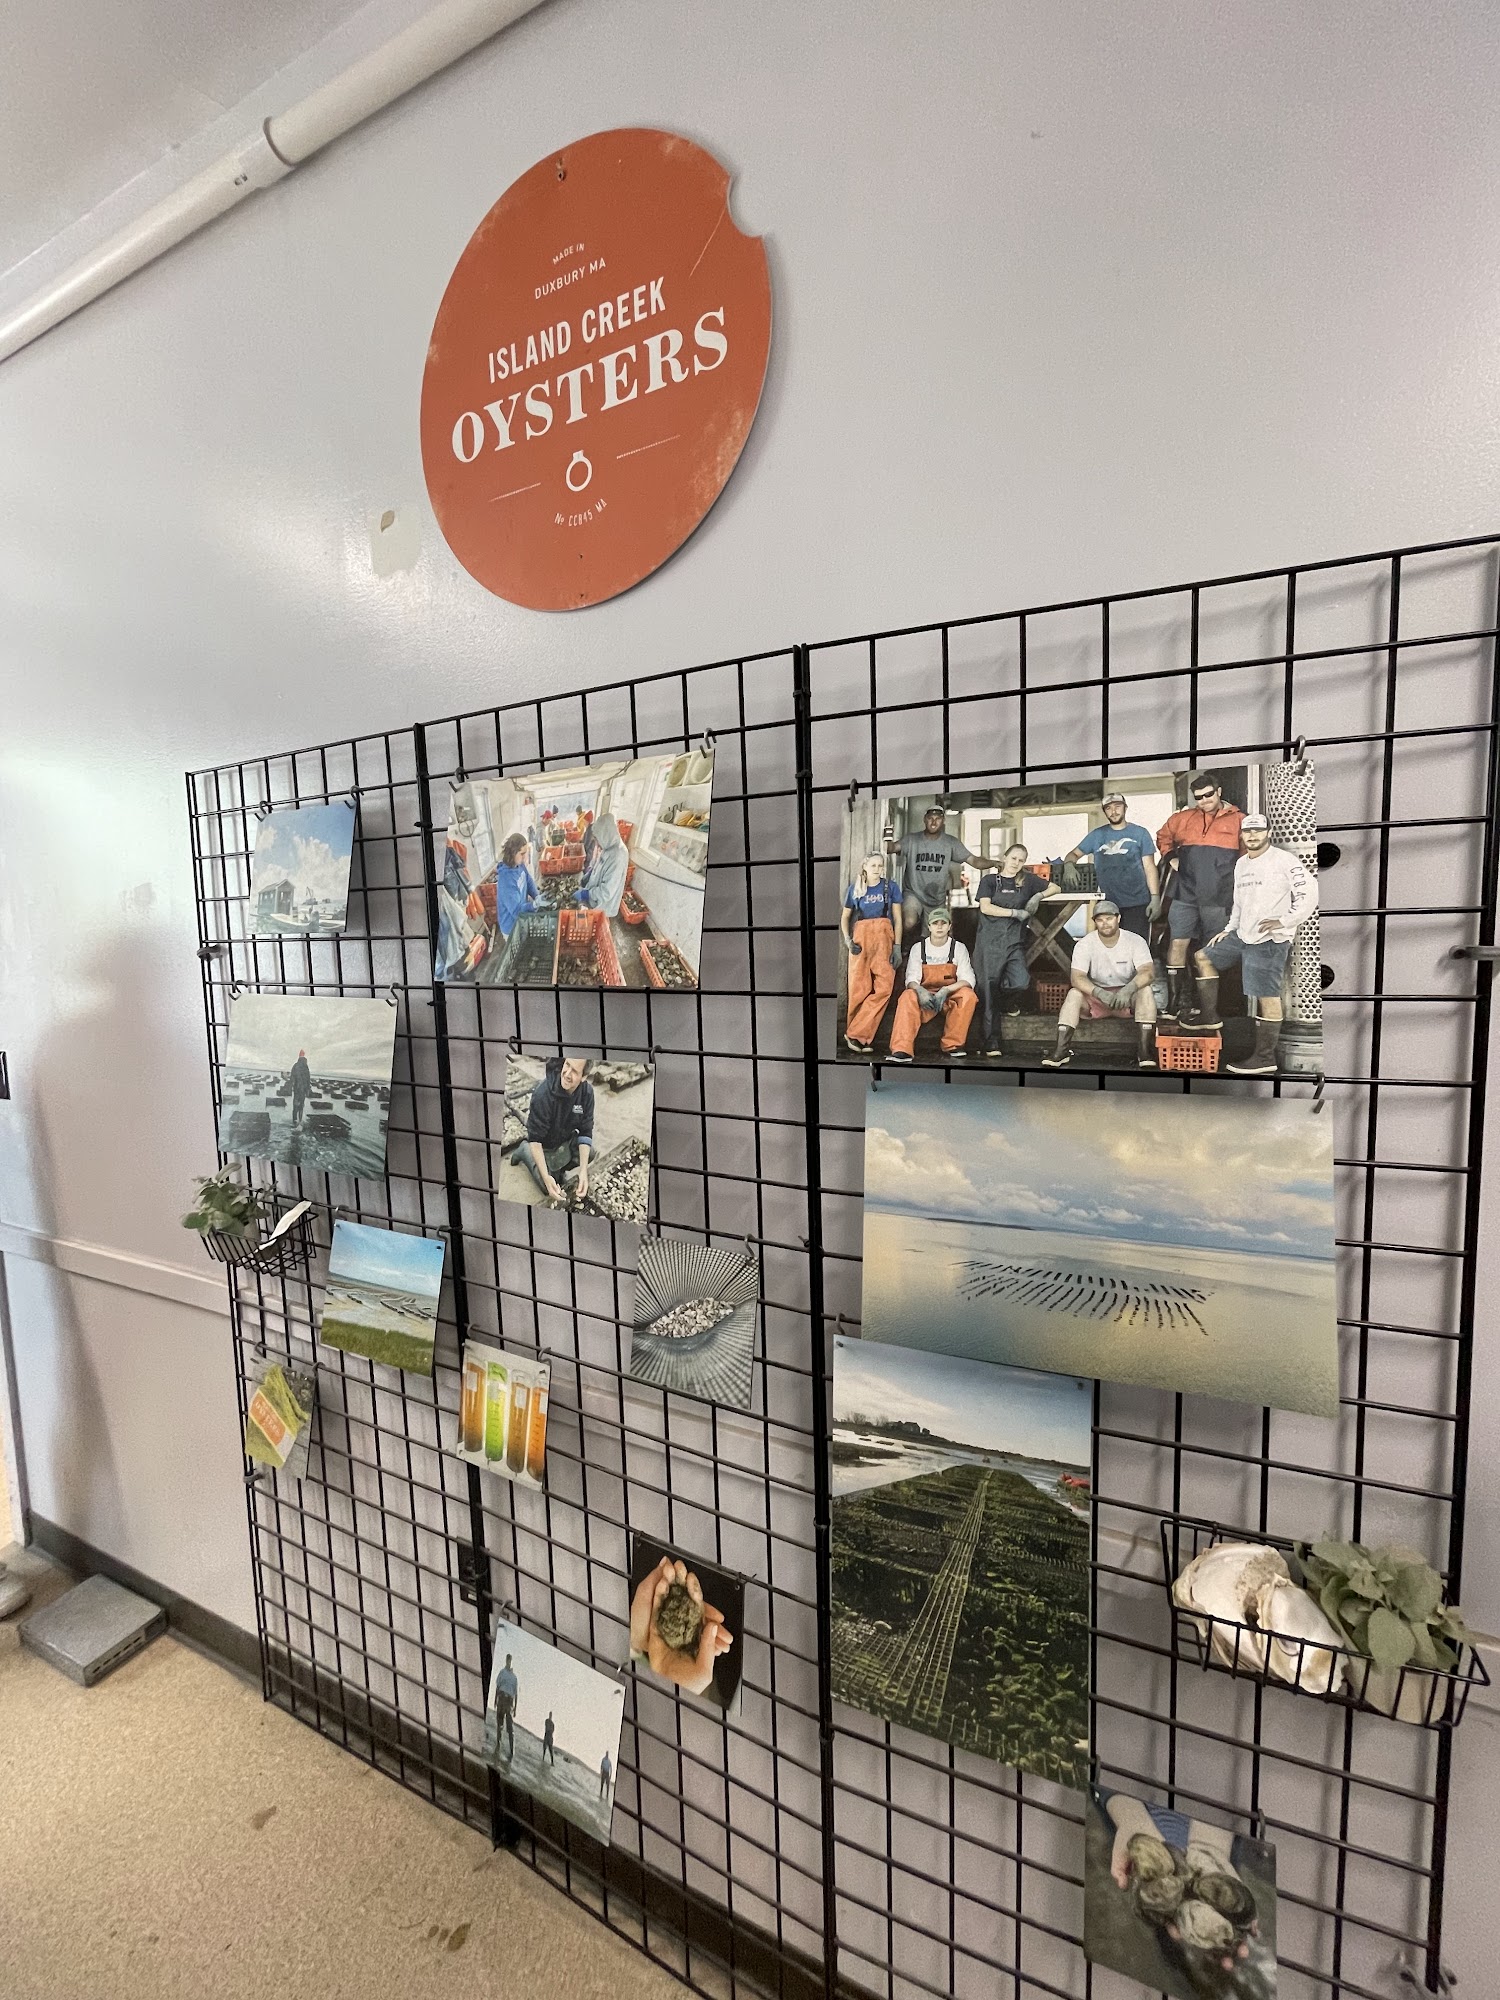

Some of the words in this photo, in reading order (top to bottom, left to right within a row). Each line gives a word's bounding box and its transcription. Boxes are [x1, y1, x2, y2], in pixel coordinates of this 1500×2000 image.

[553, 245, 574, 265] MADE
[576, 243, 585, 252] IN
[534, 265, 586, 300] DUXBURY
[589, 257, 606, 274] MA
[488, 321, 571, 384] ISLAND
[581, 276, 666, 344] CREEK
[451, 306, 728, 463] OYSTERS
[568, 508, 593, 527] CCB45
[915, 852, 946, 865] HOBART
[915, 864, 943, 873] CREW
